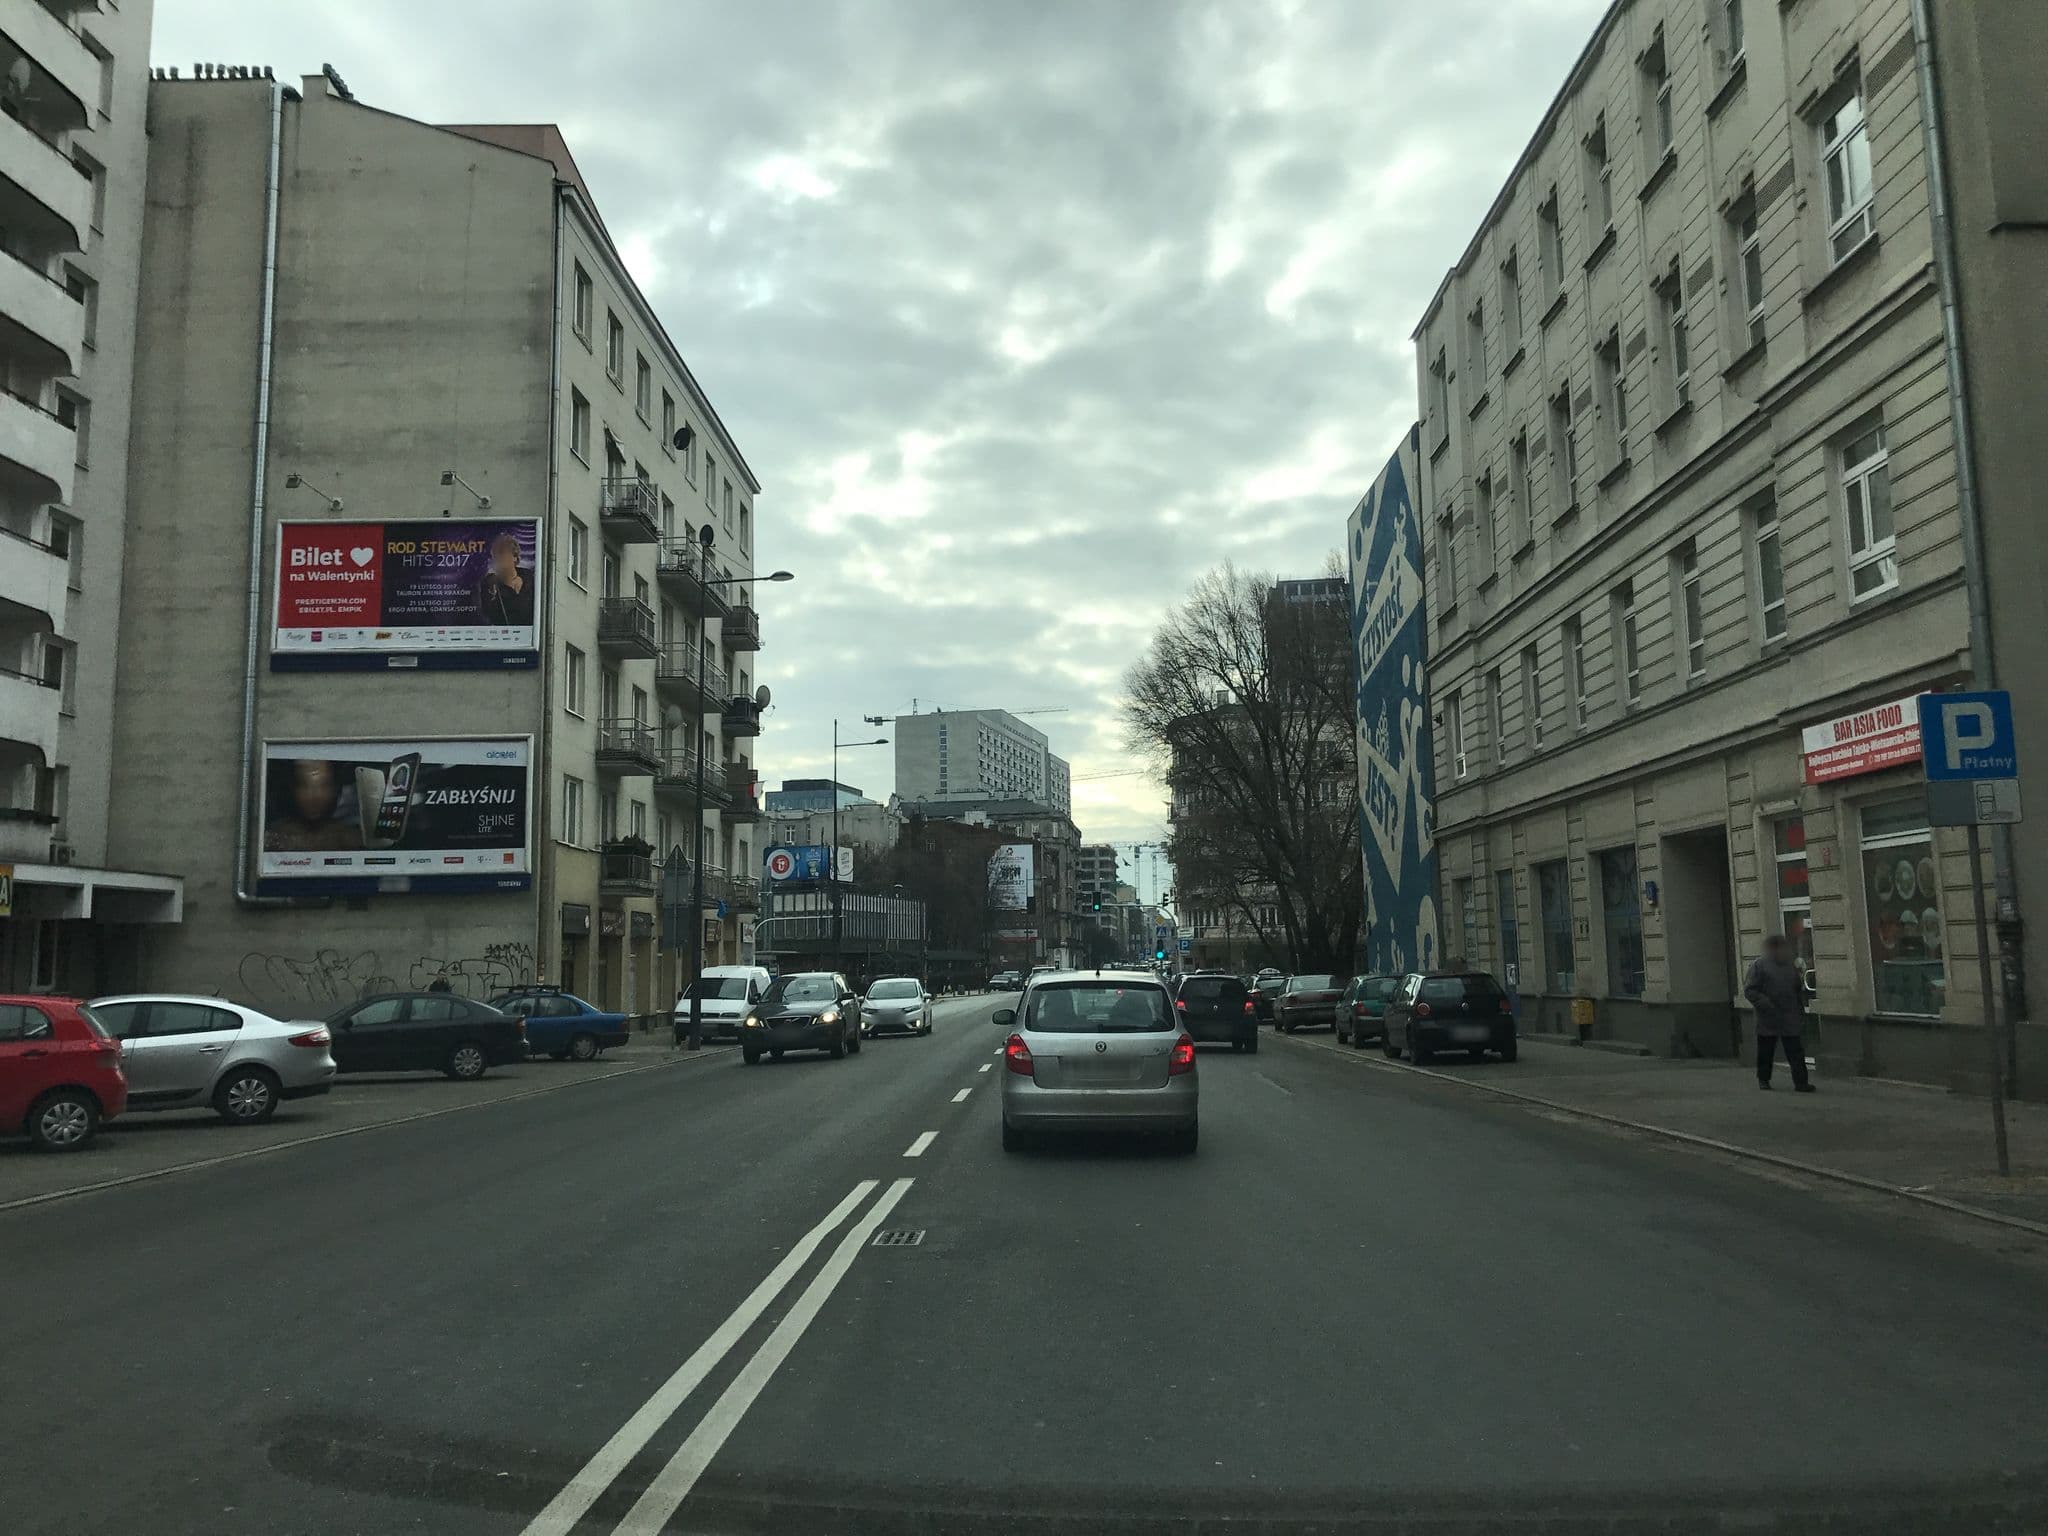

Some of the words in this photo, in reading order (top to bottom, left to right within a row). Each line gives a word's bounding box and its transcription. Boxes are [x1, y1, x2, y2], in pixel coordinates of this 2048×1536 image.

[387, 542, 416, 554] ROD
[420, 541, 485, 554] STEWART
[290, 546, 343, 566] Bilet
[402, 554, 434, 567] HITS
[437, 554, 470, 567] 2017
[289, 573, 304, 582] na
[307, 570, 374, 583] Walentynki
[1833, 719, 1852, 742] BAR
[1854, 714, 1876, 738] ASIA
[1876, 704, 1903, 729] FOOD
[1942, 702, 1995, 769] P
[425, 785, 516, 805] ZABŁYŚNIJ
[478, 814, 516, 826] SHINE
